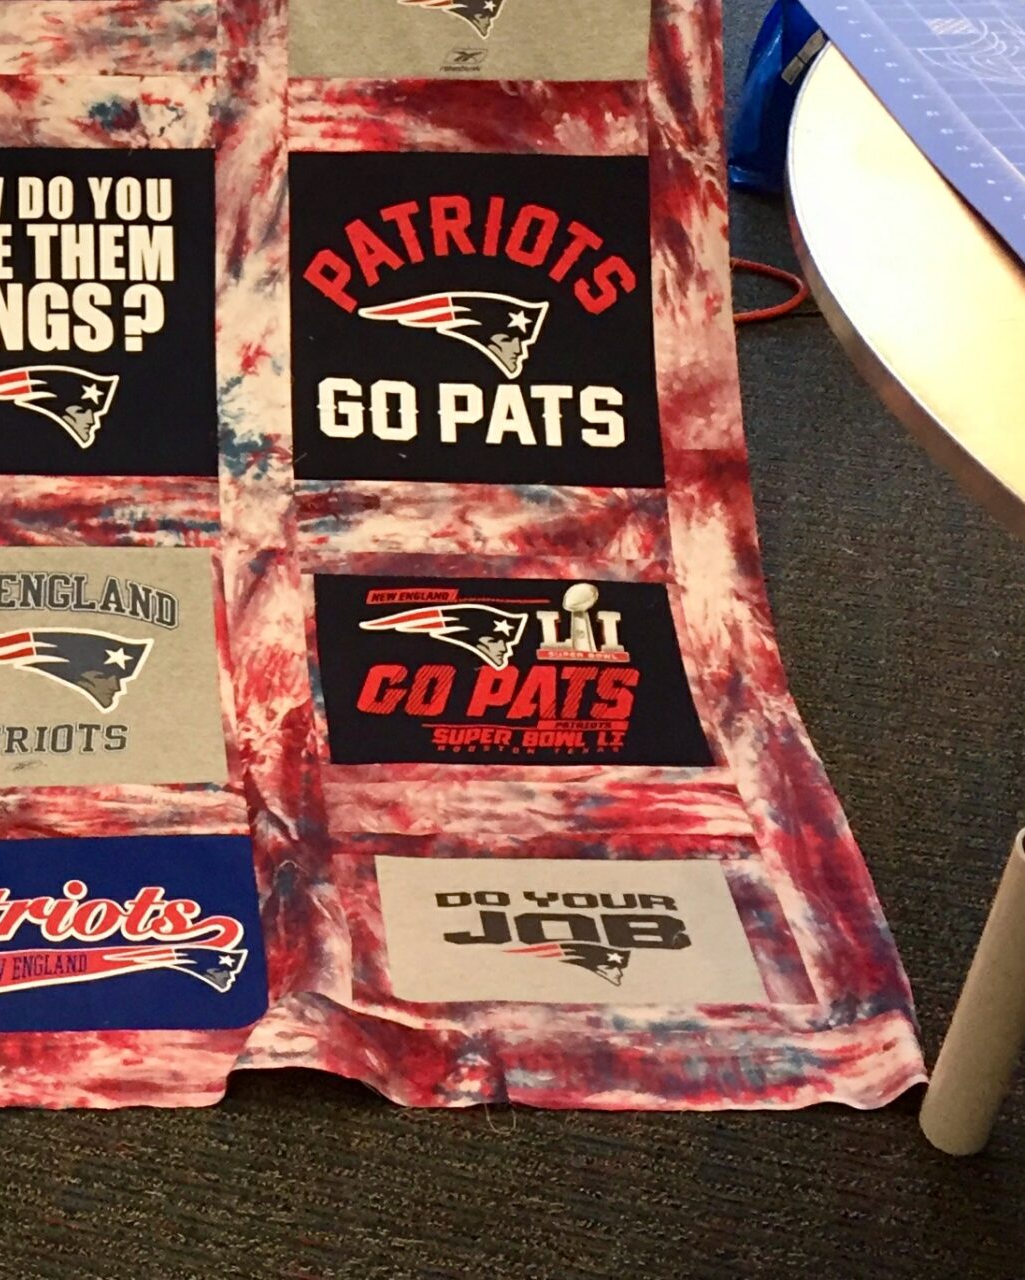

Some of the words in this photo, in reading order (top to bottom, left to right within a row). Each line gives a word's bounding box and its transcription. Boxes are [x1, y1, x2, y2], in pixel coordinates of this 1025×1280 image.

[18, 176, 74, 220] DO
[88, 177, 173, 221] YOU
[26, 224, 175, 281] THEM
[303, 195, 637, 315] PATRIOTS
[317, 377, 419, 441] GO
[438, 383, 625, 448] PATS
[371, 593, 396, 602] NEW
[399, 592, 451, 602] ENGLAND
[356, 665, 457, 716] GO
[465, 665, 640, 720] PATS
[432, 728, 512, 745] SUPER
[522, 731, 586, 747] BOWL
[597, 732, 625, 746] LI
[555, 721, 612, 729] PATRIOTS
[435, 891, 511, 908] DO
[523, 891, 678, 911] YOUR
[443, 910, 692, 950] JOB
[11, 954, 87, 980] ENGLAND
